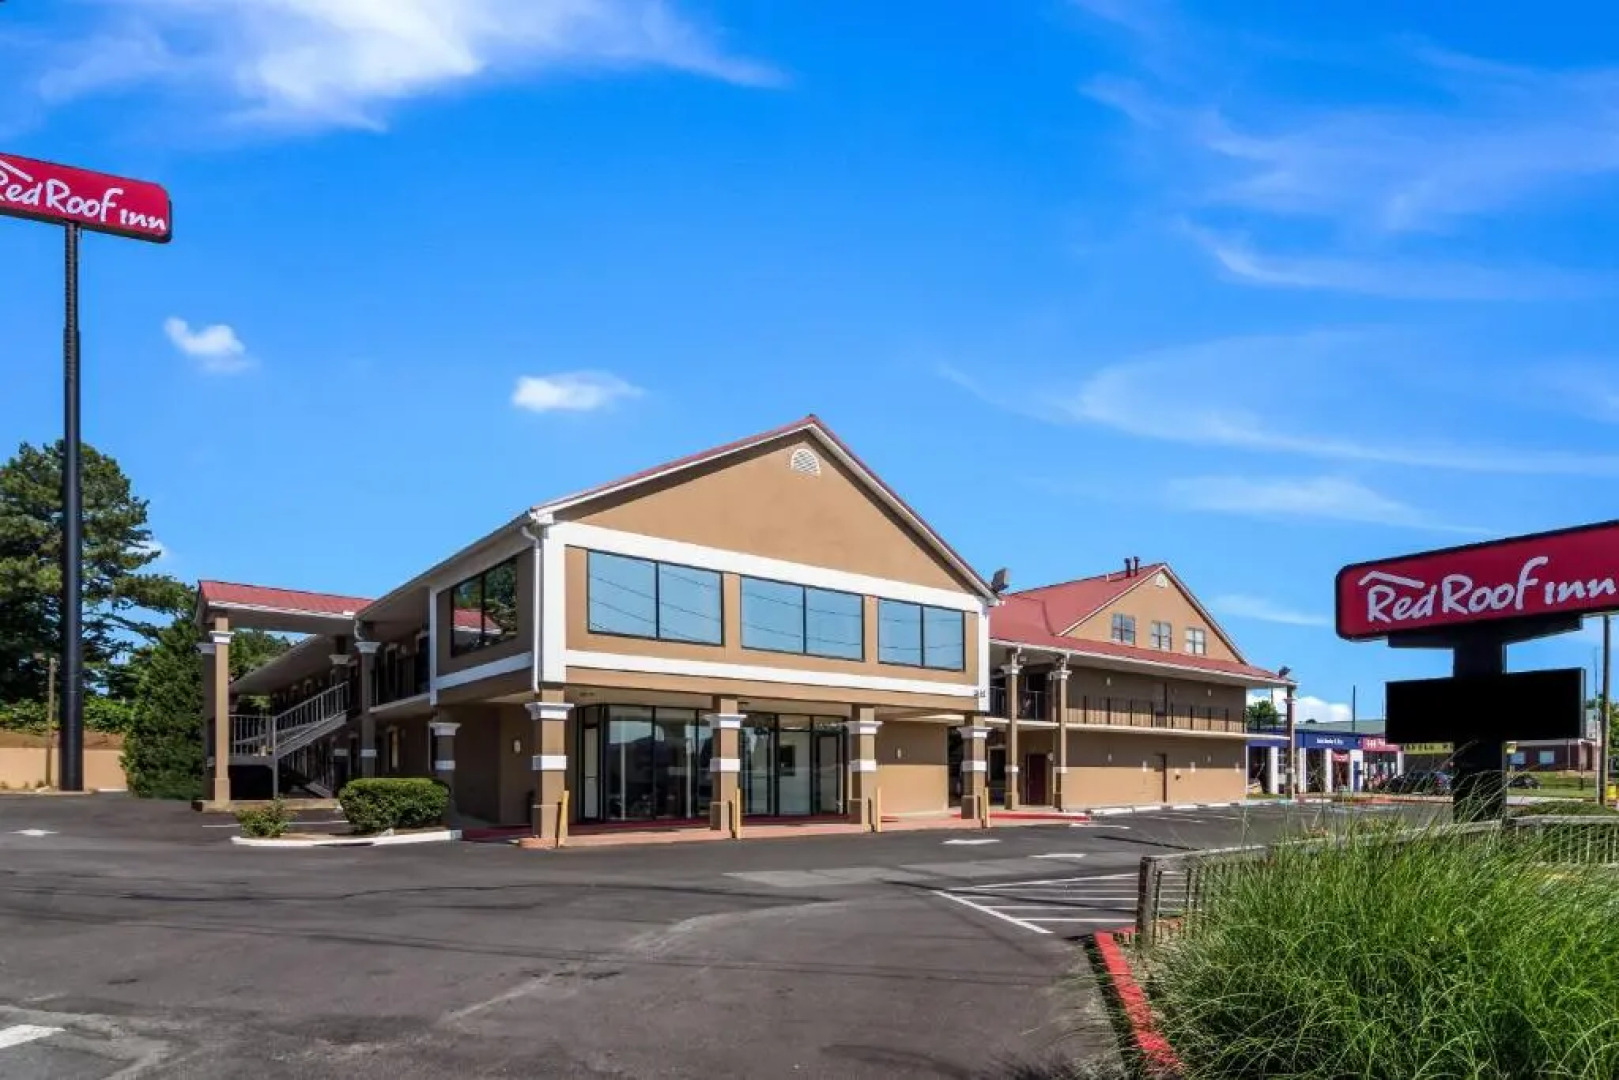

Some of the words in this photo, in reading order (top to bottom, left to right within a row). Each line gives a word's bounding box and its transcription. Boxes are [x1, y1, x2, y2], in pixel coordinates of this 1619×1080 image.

[45, 178, 124, 222] Roof
[1367, 584, 1437, 623] Red
[1441, 555, 1549, 615] Roof
